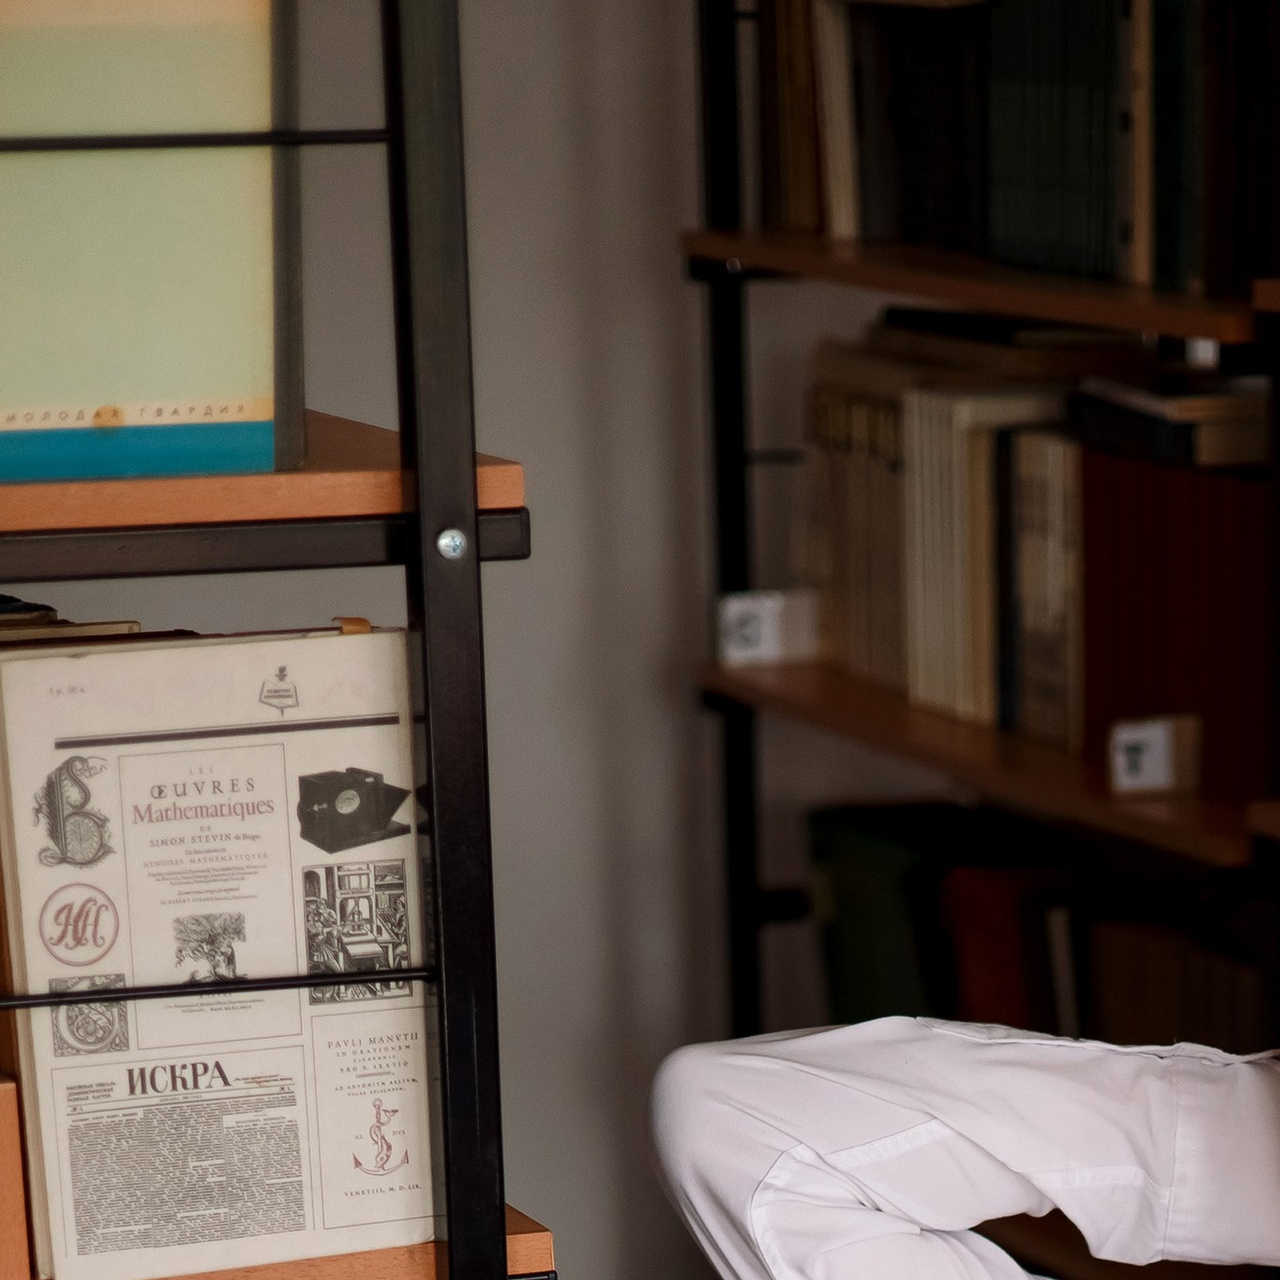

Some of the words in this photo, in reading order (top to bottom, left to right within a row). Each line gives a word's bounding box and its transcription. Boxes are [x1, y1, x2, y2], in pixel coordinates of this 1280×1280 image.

[6, 408, 120, 422] МОЛОДАЯ
[140, 404, 244, 417] ГВАРДИЯ
[150, 777, 257, 799] ŒUVRES
[132, 797, 276, 825] Mathematiques
[127, 1060, 232, 1097] ИСКРА
